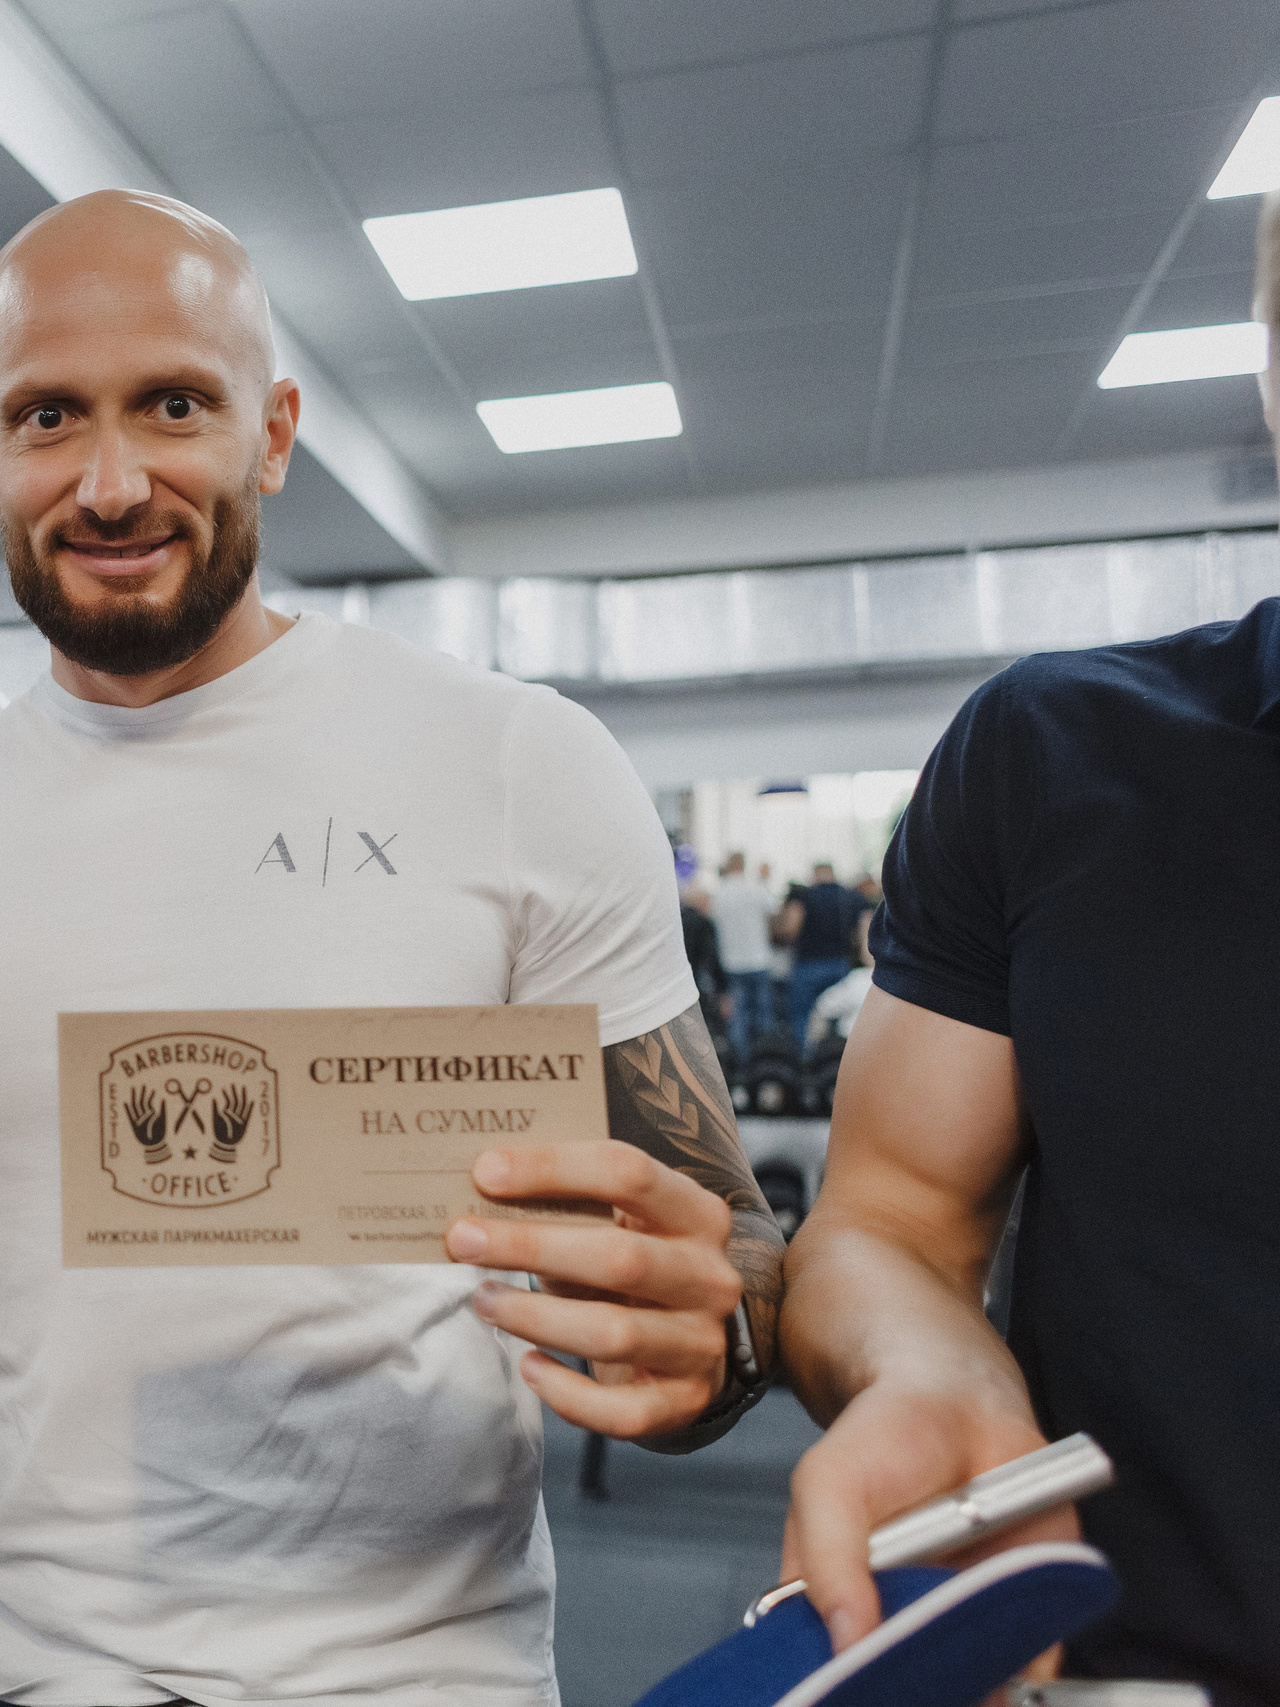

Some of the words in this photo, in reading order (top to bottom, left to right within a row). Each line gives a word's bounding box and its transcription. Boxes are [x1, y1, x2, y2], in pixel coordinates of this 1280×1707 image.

[120, 1043, 258, 1078] BARBERSHOP
[308, 1054, 584, 1084] СЕРТИФИКАТ
[260, 1080, 270, 1156] 2017
[360, 1109, 406, 1134] НА
[415, 1107, 536, 1134] СУММУ
[86, 1230, 159, 1244] МУЖСКАЯ
[162, 1228, 300, 1244] ПАРИКМАХЕРСКАЯ
